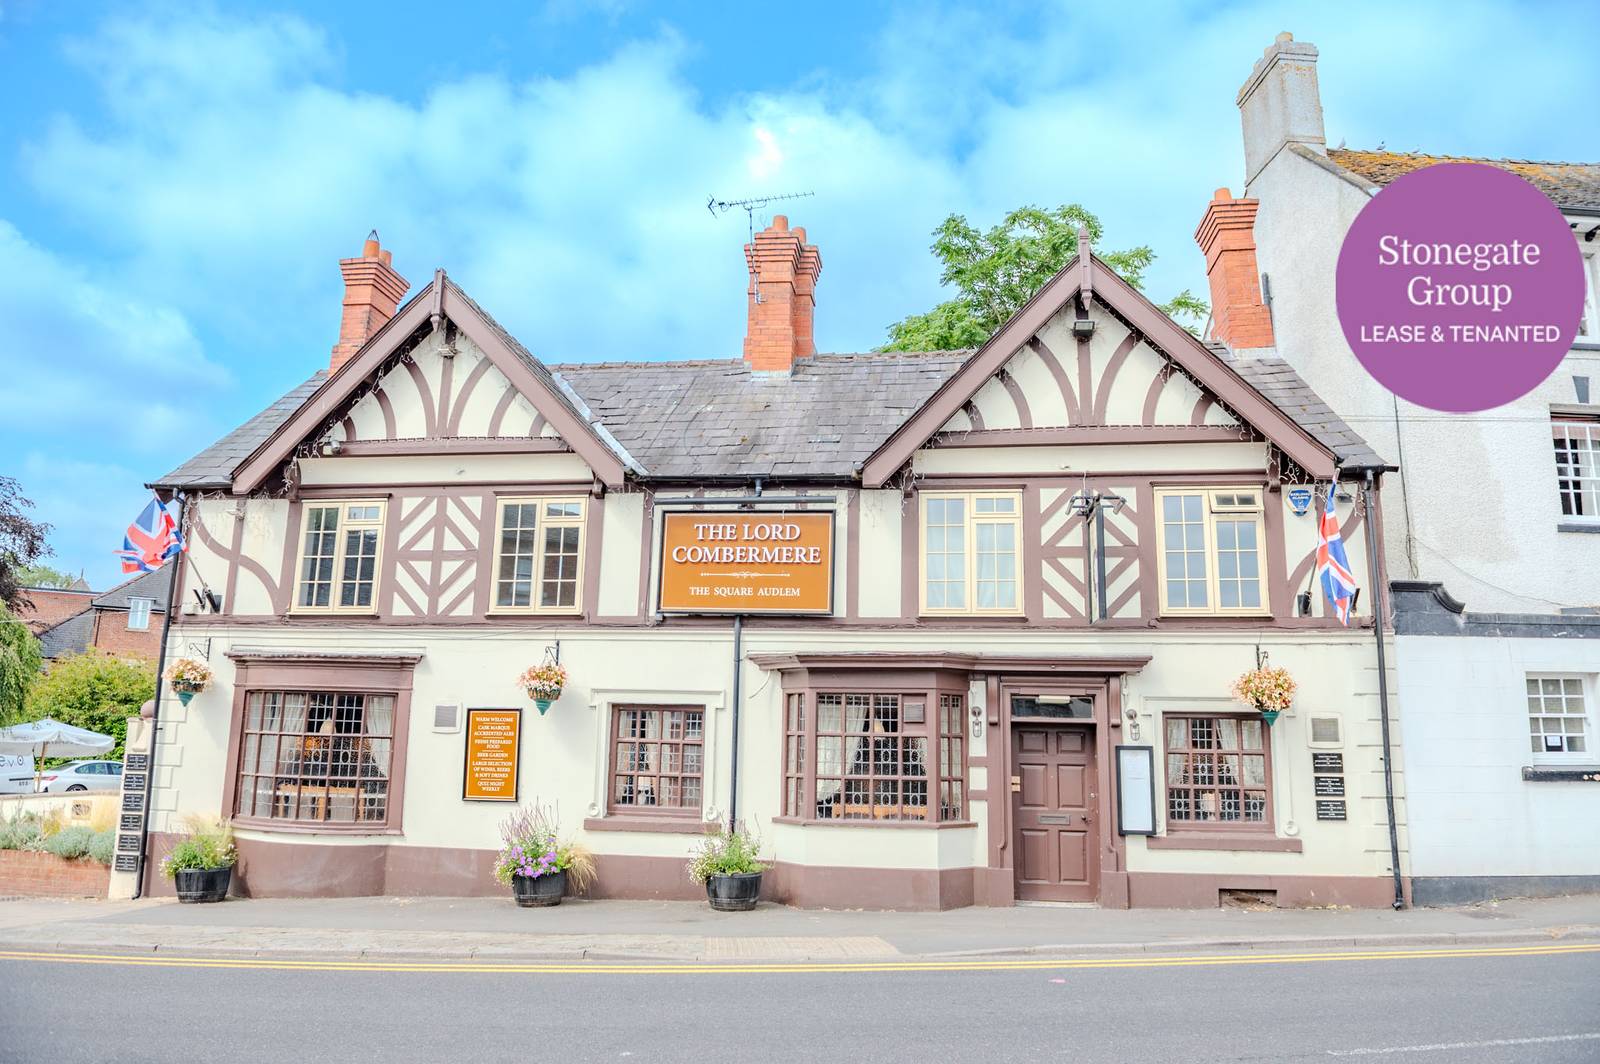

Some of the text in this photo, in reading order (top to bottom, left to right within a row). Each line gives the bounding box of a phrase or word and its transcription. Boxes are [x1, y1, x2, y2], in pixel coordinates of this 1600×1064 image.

[694, 524, 801, 541] THE LORD
[672, 546, 821, 563] COMBERMERE
[689, 587, 800, 597] THE SQUARE AUDLEM
